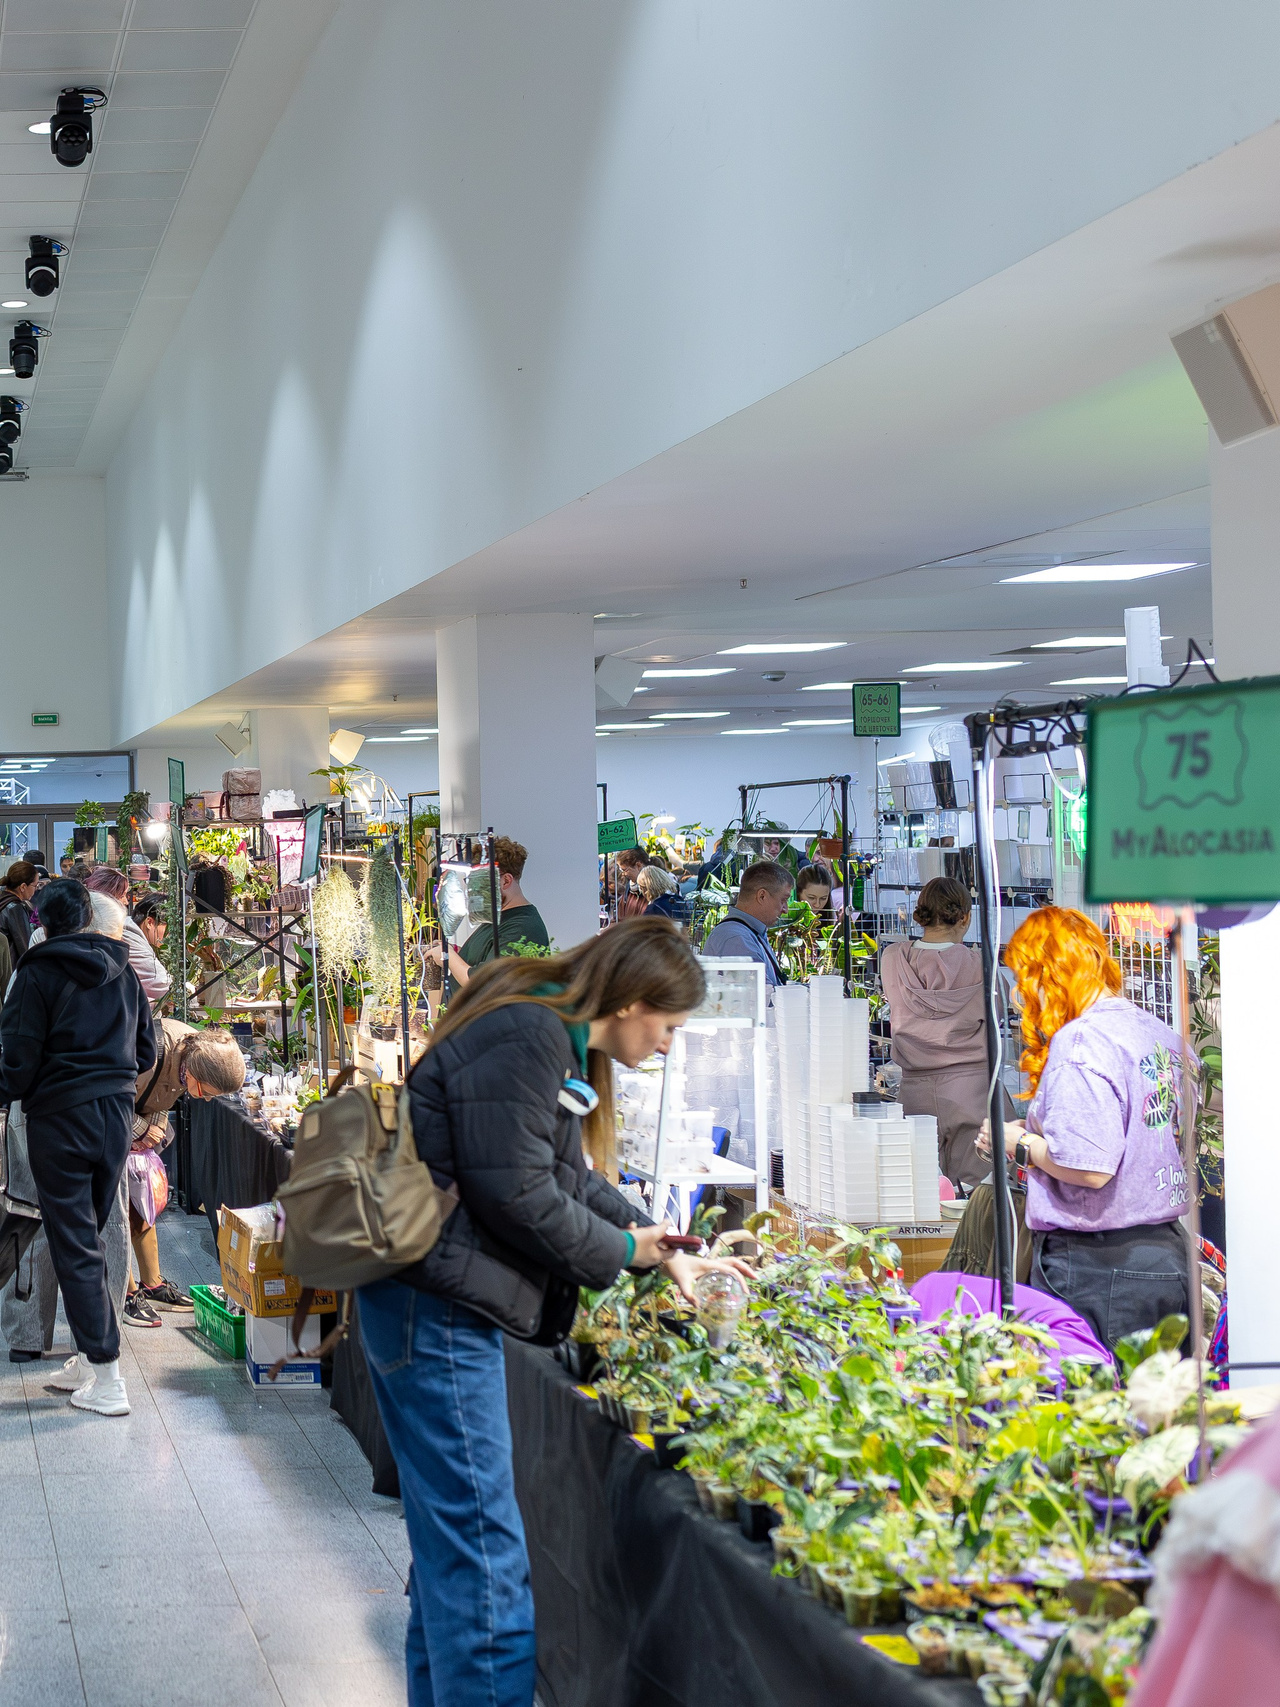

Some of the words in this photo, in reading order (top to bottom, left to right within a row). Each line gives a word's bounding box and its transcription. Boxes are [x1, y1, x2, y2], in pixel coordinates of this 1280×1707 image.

[862, 693, 889, 706] 65-66
[855, 725, 867, 733] ПОД
[869, 725, 897, 733] ЦВЕТОЧЕК
[1166, 729, 1212, 781] 75
[599, 825, 624, 837] 61-62
[1154, 1166, 1168, 1191] I
[898, 1225, 942, 1235] ARTKRON
